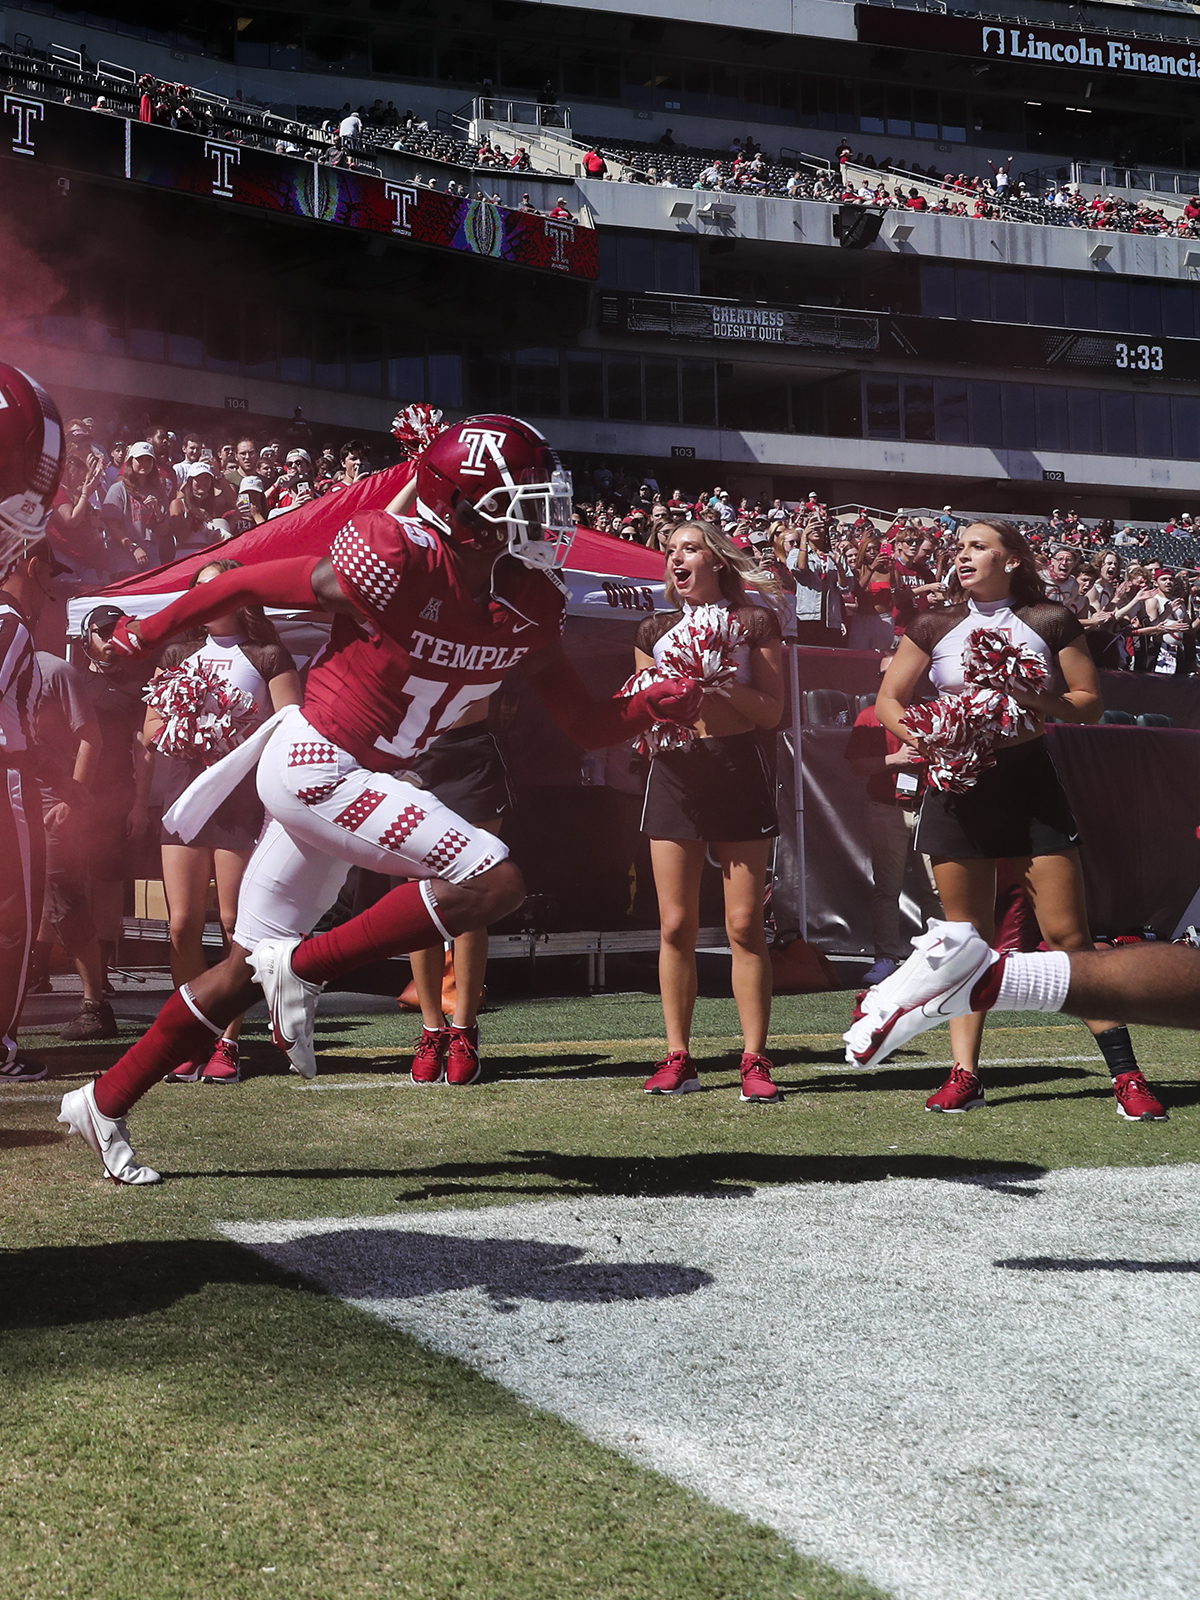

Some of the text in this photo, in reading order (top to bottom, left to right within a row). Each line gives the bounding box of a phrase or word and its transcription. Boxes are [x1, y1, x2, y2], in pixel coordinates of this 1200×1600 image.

[1010, 30, 1200, 78] Lincoln Financi
[712, 306, 785, 327] GREATNESS
[713, 322, 757, 339] DOESN'T
[1115, 343, 1164, 371] 3:33
[227, 398, 246, 410] 104
[674, 447, 693, 458] 103
[1045, 471, 1062, 481] 102
[20, 500, 37, 516] 215
[601, 582, 655, 612] OWLS
[409, 630, 530, 671] TEMPLE
